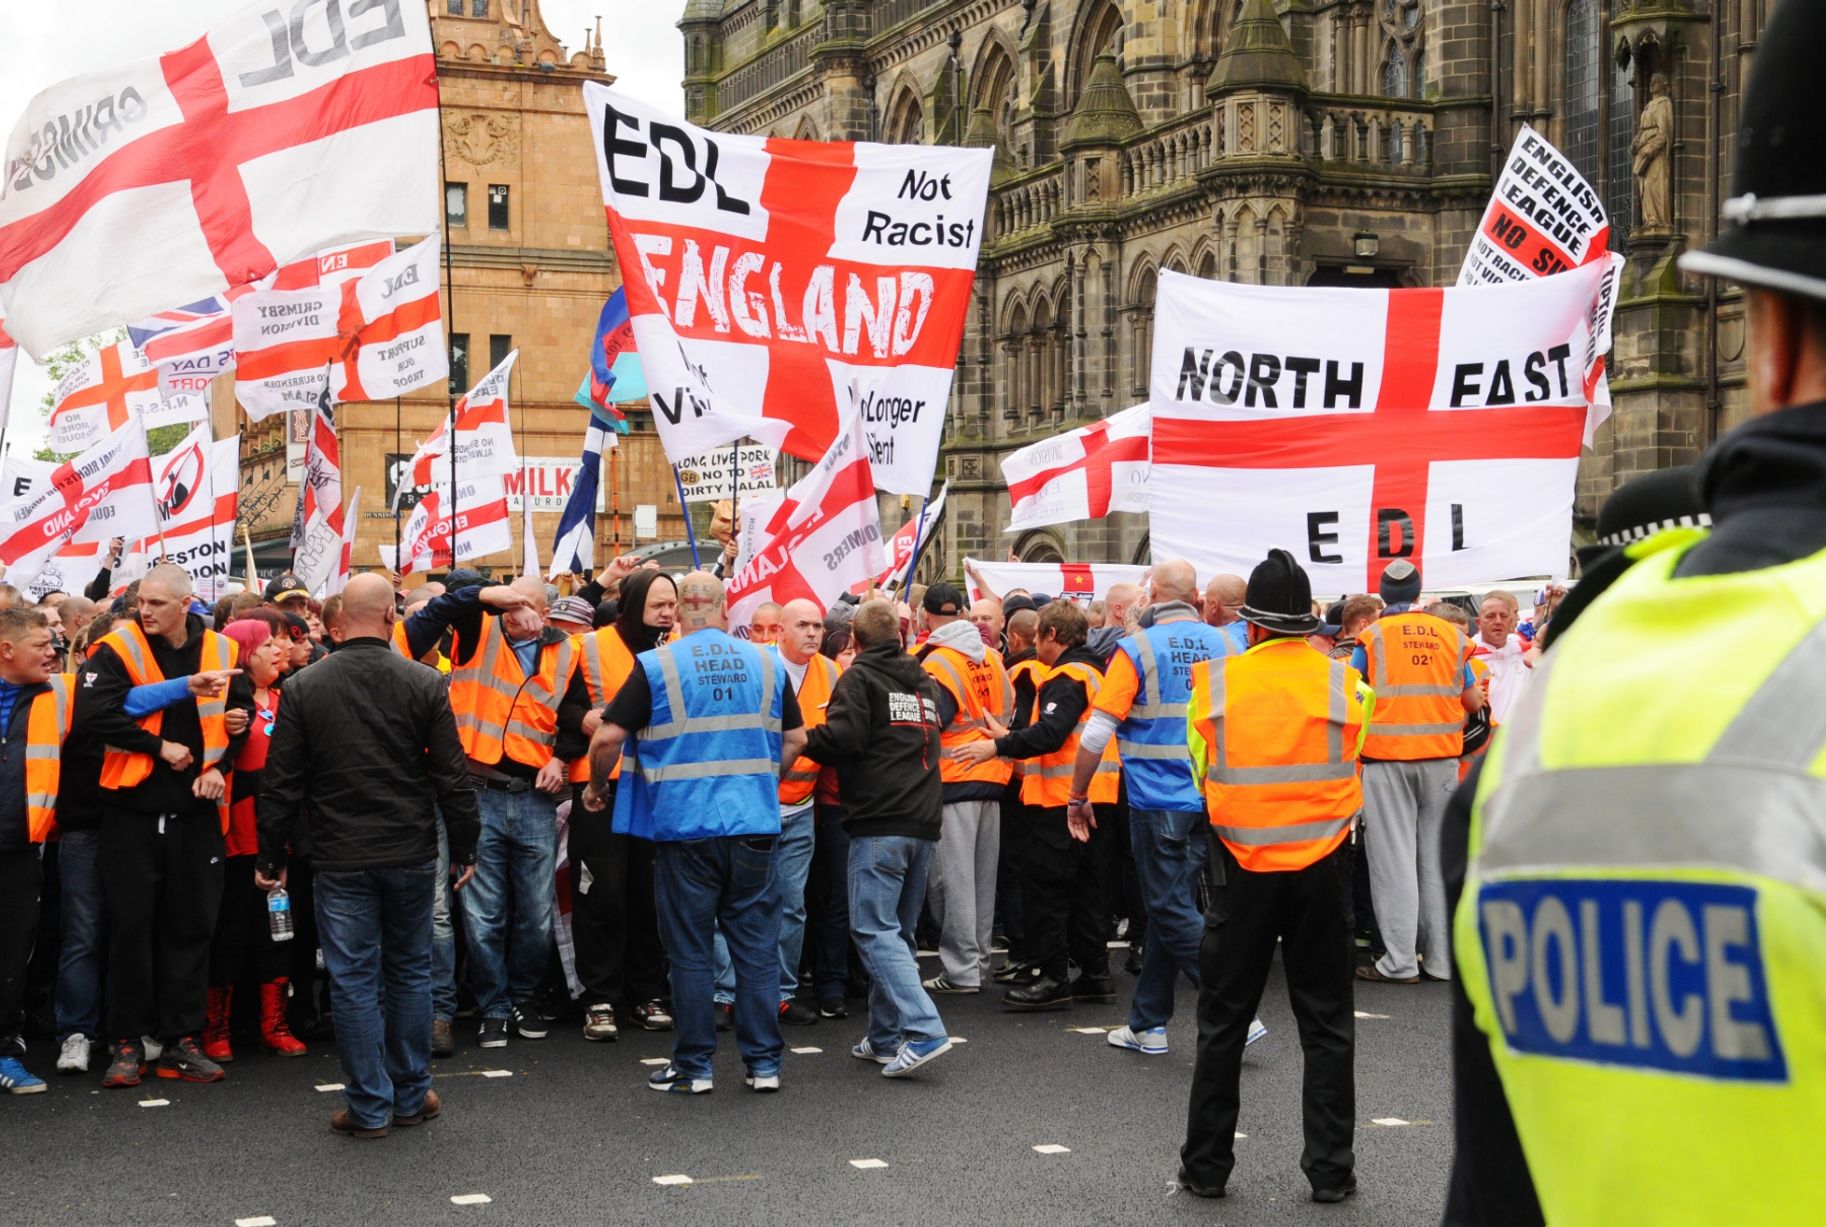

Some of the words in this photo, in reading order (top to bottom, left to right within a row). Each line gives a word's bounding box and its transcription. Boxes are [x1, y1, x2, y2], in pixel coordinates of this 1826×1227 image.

[604, 103, 750, 215] EDL
[898, 168, 953, 201] Not
[1510, 156, 1593, 238] DEFENCE
[862, 210, 974, 250] Racist
[1491, 212, 1527, 249] NO
[1500, 177, 1583, 257] LEAGUE
[631, 232, 935, 359] ENGLAND
[1175, 347, 1365, 409] NORTH
[1450, 343, 1572, 408] EAST
[677, 455, 707, 469] LONG
[740, 450, 772, 464] PORK
[702, 471, 723, 481] NO
[727, 468, 745, 478] TO
[682, 484, 723, 497] DIRTY
[728, 480, 774, 492] HALAL
[695, 657, 745, 673] HEAD
[1412, 654, 1433, 666] 021
[698, 672, 748, 686] STEWARD
[712, 687, 733, 702] 01
[890, 711, 922, 722] LEAGUE
[1482, 895, 1774, 1061] POLICE
